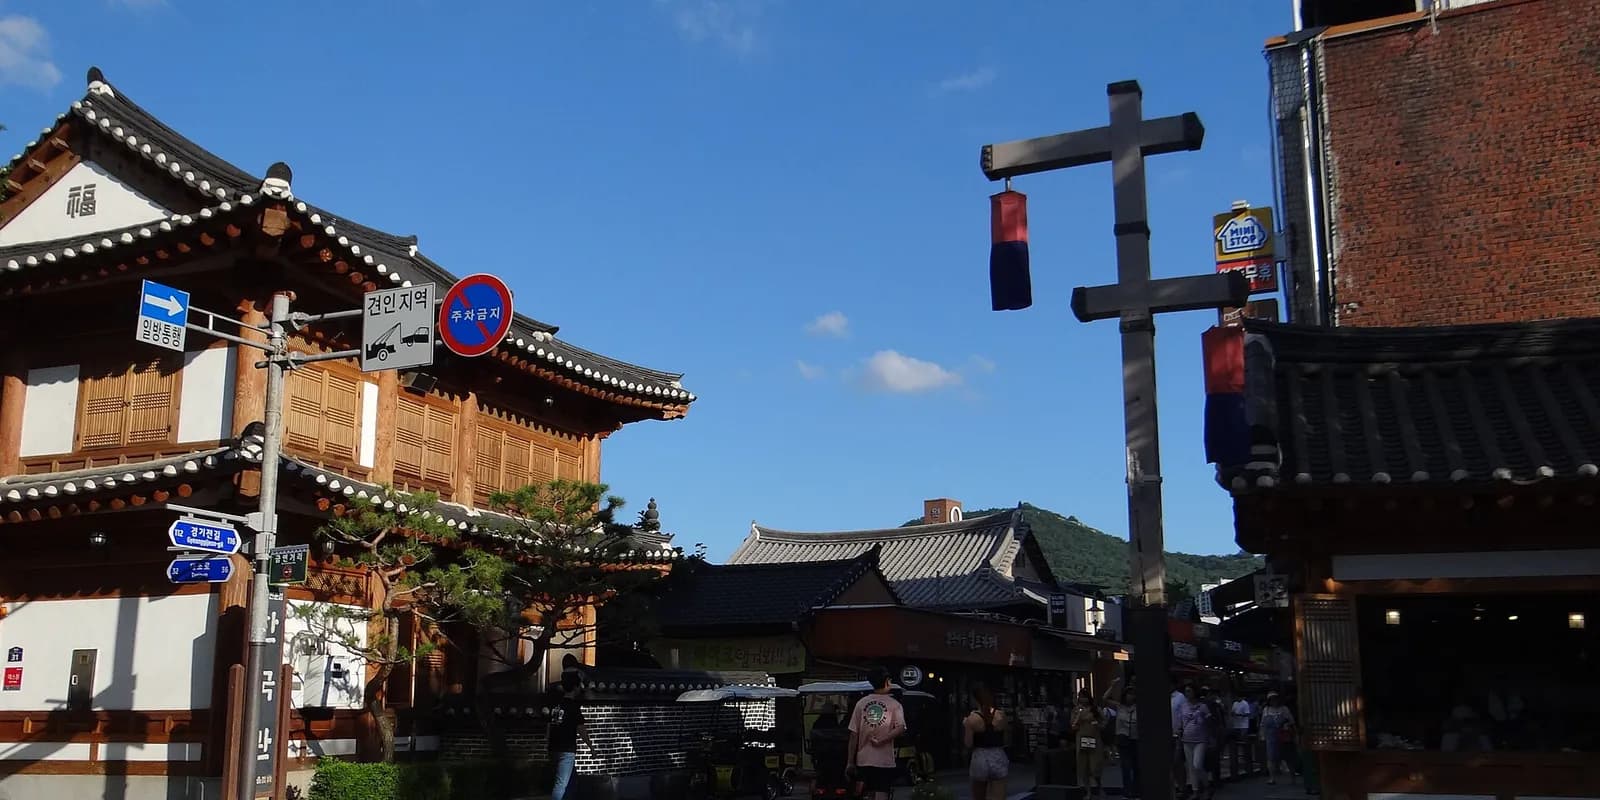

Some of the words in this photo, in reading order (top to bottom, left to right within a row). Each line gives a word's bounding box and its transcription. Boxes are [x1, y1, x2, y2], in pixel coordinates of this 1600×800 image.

[67, 184, 97, 219] 福
[1230, 226, 1256, 237] MINI
[1230, 235, 1257, 247] STOP
[451, 306, 501, 323] 주차금지
[143, 319, 182, 347] 일방통행
[174, 529, 184, 538] 112
[191, 526, 221, 541] 경기전길
[275, 552, 303, 565] 금연거리
